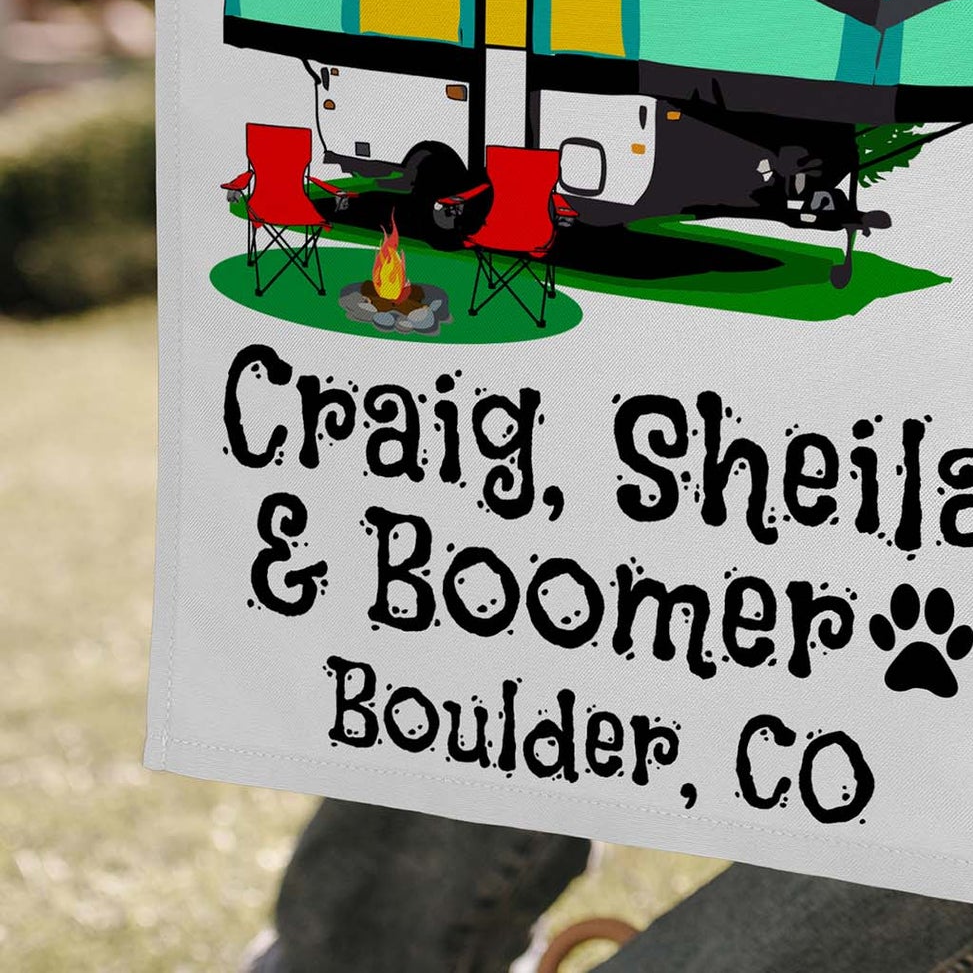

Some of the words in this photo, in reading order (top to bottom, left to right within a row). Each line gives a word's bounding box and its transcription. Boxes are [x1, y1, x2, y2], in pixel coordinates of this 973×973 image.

[223, 344, 564, 521] Craig,
[248, 493, 328, 616] &
[360, 506, 857, 680] Boomer
[324, 656, 697, 808] Boulder,
[735, 714, 875, 824] CO
